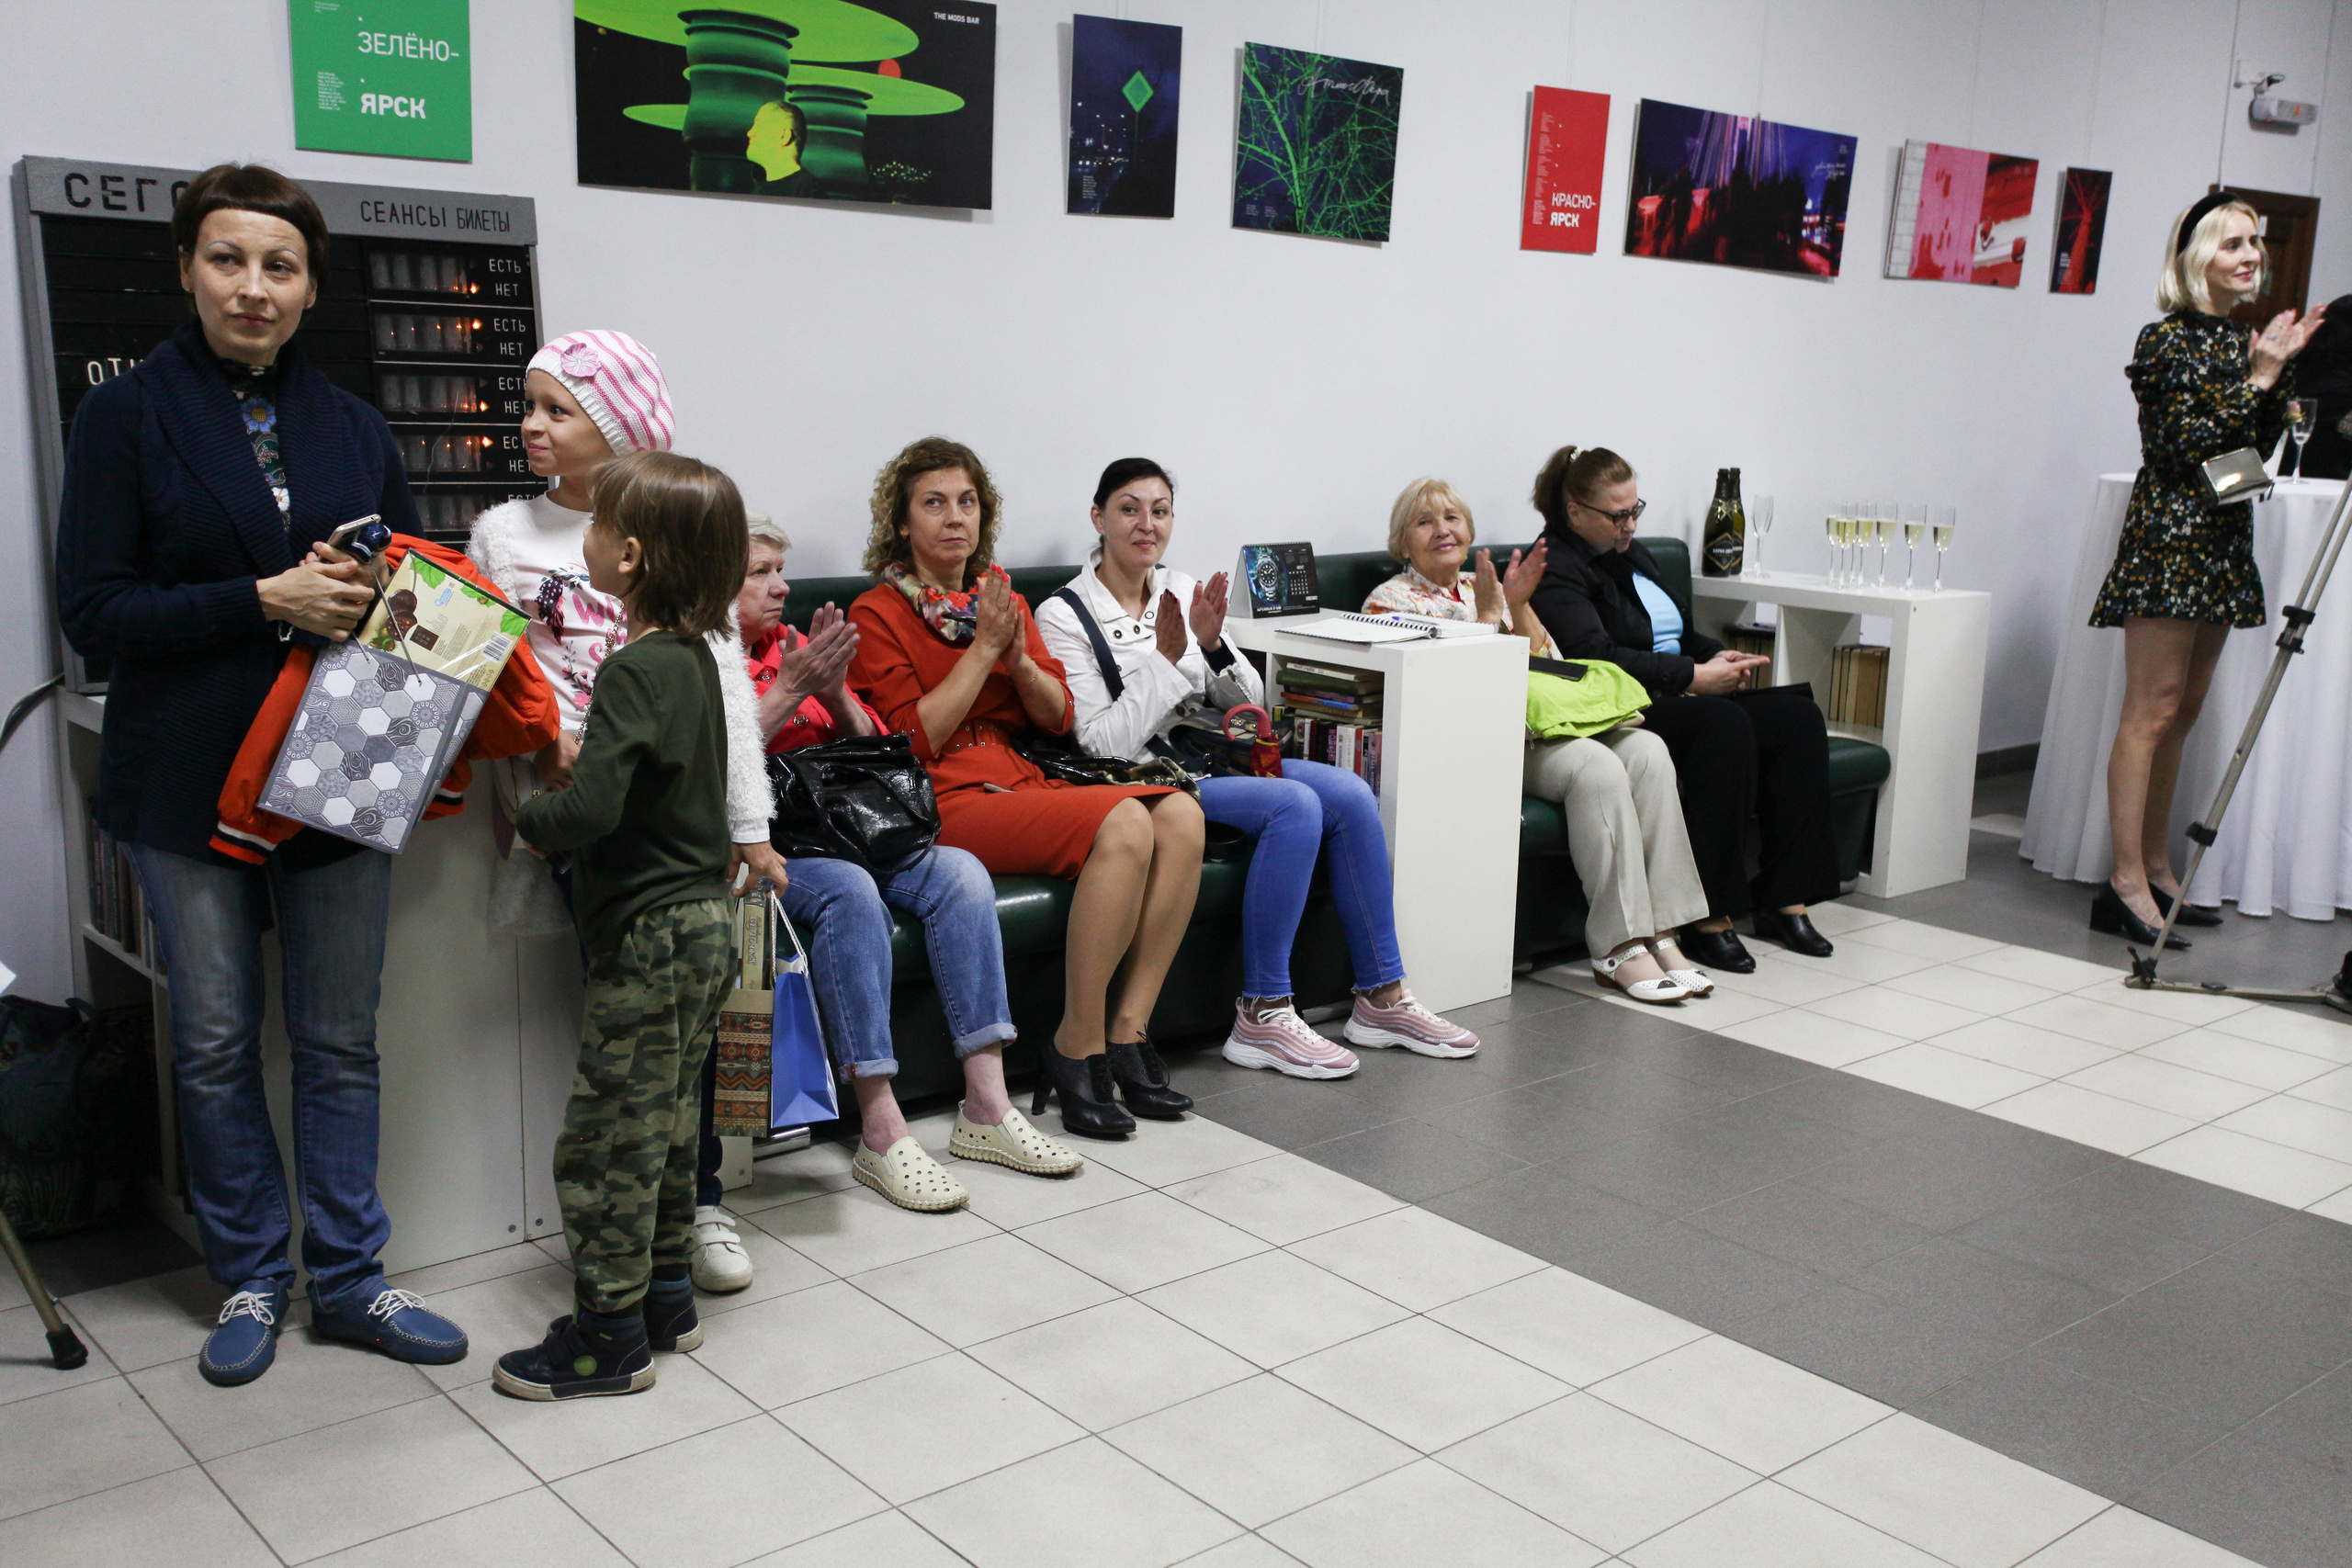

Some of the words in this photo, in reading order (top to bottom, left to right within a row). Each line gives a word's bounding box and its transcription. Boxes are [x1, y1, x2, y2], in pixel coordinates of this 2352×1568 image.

[933, 12, 946, 20] THE
[947, 14, 966, 22] MODS
[967, 16, 980, 25] BAR
[357, 31, 459, 62] ЗЕЛЁНО-
[360, 93, 426, 119] ЯРСК
[1551, 192, 1596, 209] КРАСНО-
[360, 200, 447, 228] СЕАНСЫ
[456, 208, 510, 231] БИЛЕТЫ
[1549, 211, 1580, 228] ЯРСК
[489, 258, 522, 274] ЕСТЬ
[495, 283, 518, 297] НЕТ
[493, 318, 526, 333] ЕСТЬ
[500, 343, 523, 355] НЕТ
